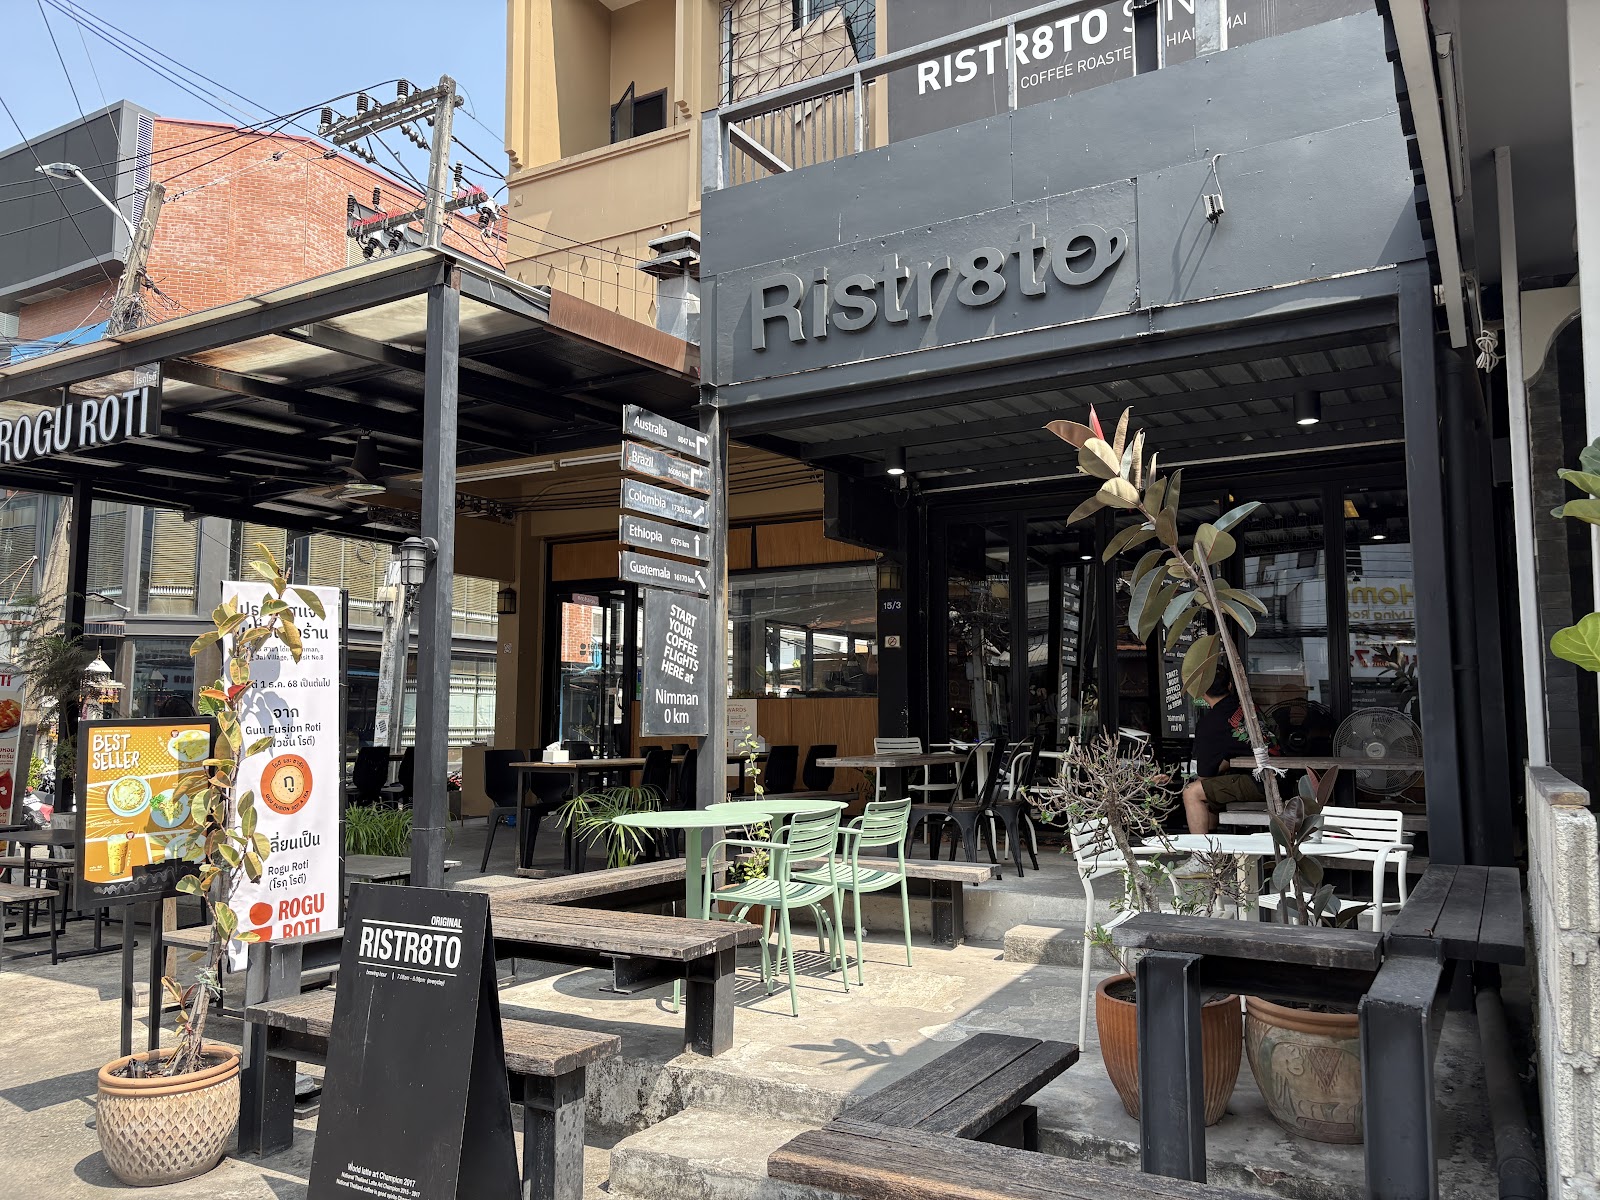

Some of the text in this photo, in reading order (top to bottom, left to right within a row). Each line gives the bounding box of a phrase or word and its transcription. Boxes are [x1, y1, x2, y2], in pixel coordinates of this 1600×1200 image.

[917, 10, 1109, 95] RISTR8TO
[1020, 64, 1074, 89] COFFEE
[1077, 46, 1132, 73] ROASTE
[751, 222, 1129, 352] Ristr8to
[0, 387, 149, 463] ROGU ROTI
[634, 415, 696, 448] Australia 8047 km
[631, 450, 654, 468] Brazil
[681, 470, 689, 481] km
[628, 488, 667, 509] Colombia
[684, 506, 693, 516] km
[629, 524, 690, 548] Ethiopia 6575 km
[629, 561, 671, 580] Guatemala
[687, 575, 695, 585] km
[670, 604, 697, 628] START
[883, 600, 902, 610] 15/3
[669, 618, 693, 640] YOUR
[665, 632, 698, 657] COFFEE
[663, 645, 699, 672] FLIGHTS
[287, 679, 298, 688] 68
[661, 659, 694, 684] HERE at
[655, 688, 699, 706] Nimman
[273, 706, 300, 719] จาก
[664, 708, 690, 724] 0 km
[245, 722, 321, 736] Guu Fusion Roti
[93, 733, 132, 753] BEST
[92, 750, 141, 771] SELLER
[268, 859, 309, 877] Rogu Roti
[278, 893, 325, 921] ROGU
[282, 918, 321, 939] ROTI
[430, 915, 463, 929] ORIGINAL
[359, 926, 462, 969] RISTR8TO
[379, 1171, 404, 1184] Champion
[403, 1177, 416, 1188] 2017
